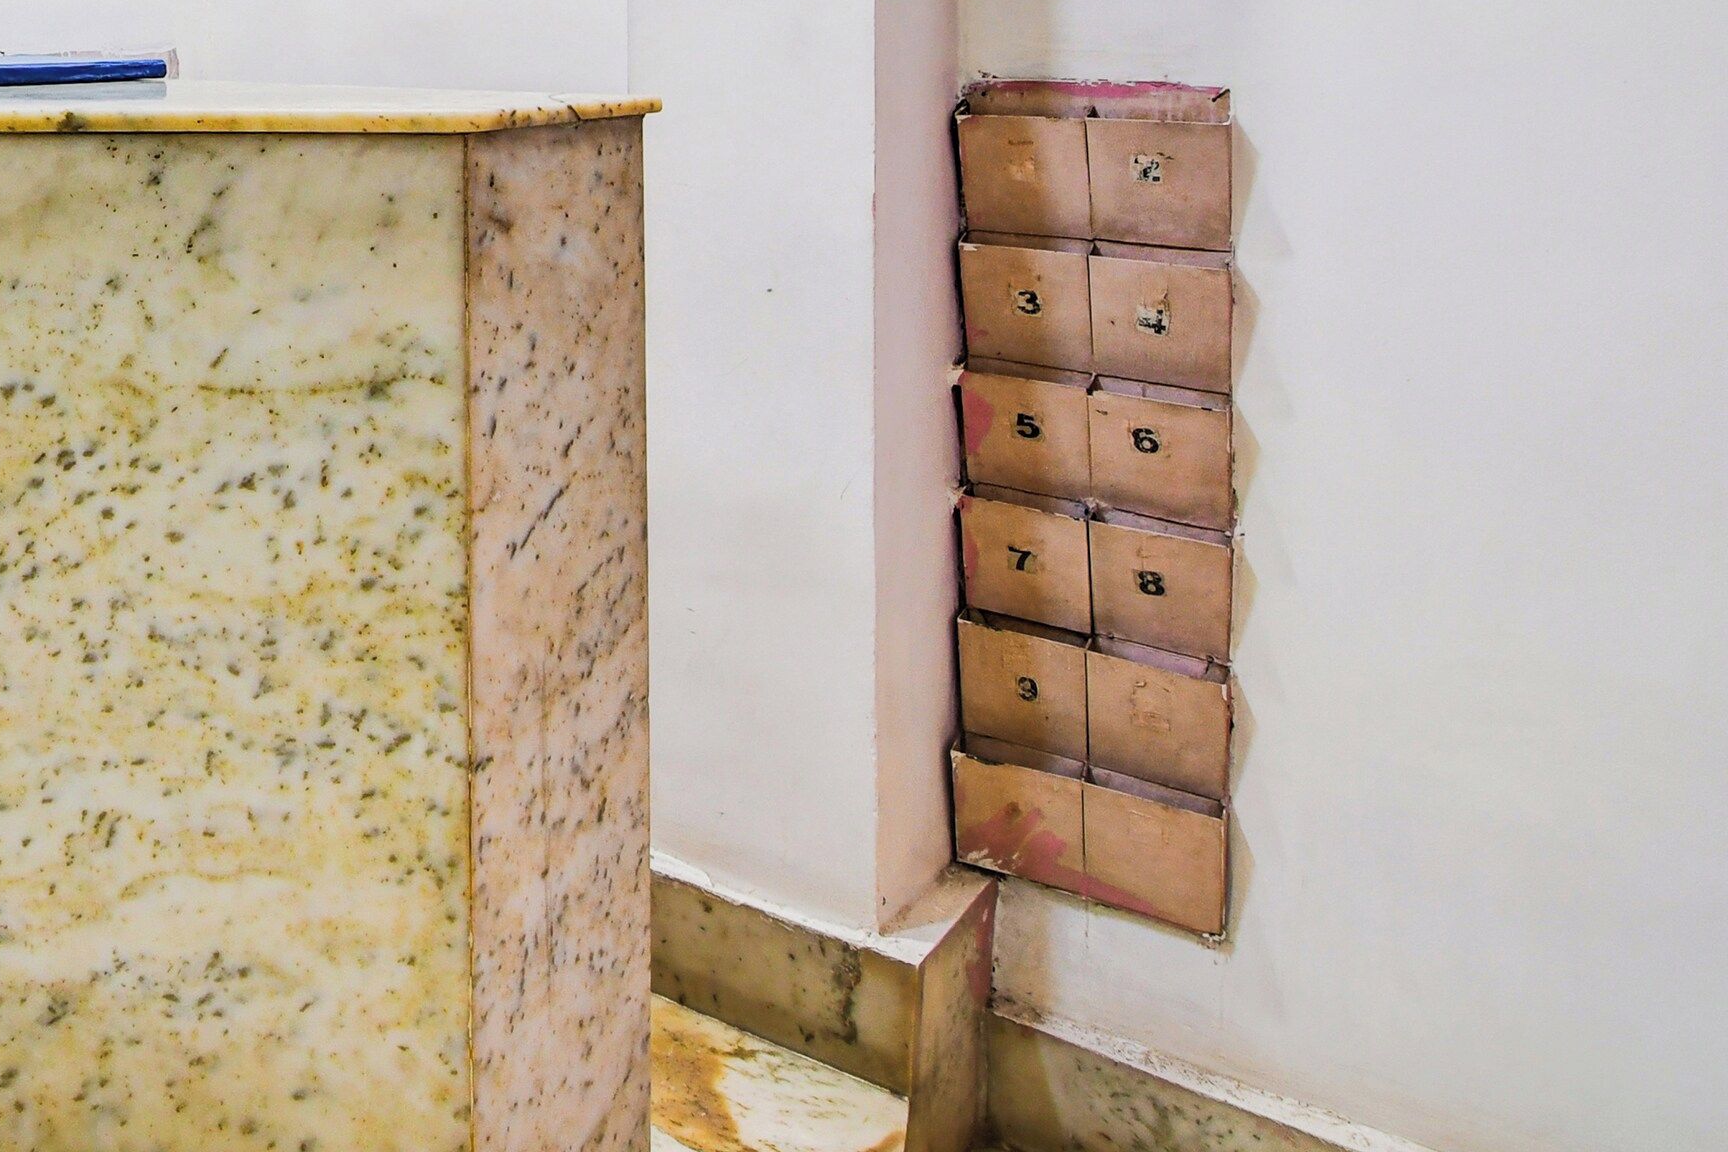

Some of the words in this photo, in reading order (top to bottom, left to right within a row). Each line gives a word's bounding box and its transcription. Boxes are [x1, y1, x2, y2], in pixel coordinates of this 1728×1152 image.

[1017, 289, 1042, 315] 3
[1016, 412, 1042, 439] 5
[1132, 427, 1160, 454] 6
[1007, 544, 1032, 572] 7
[1138, 570, 1166, 597] 8
[1017, 676, 1039, 703] 9
